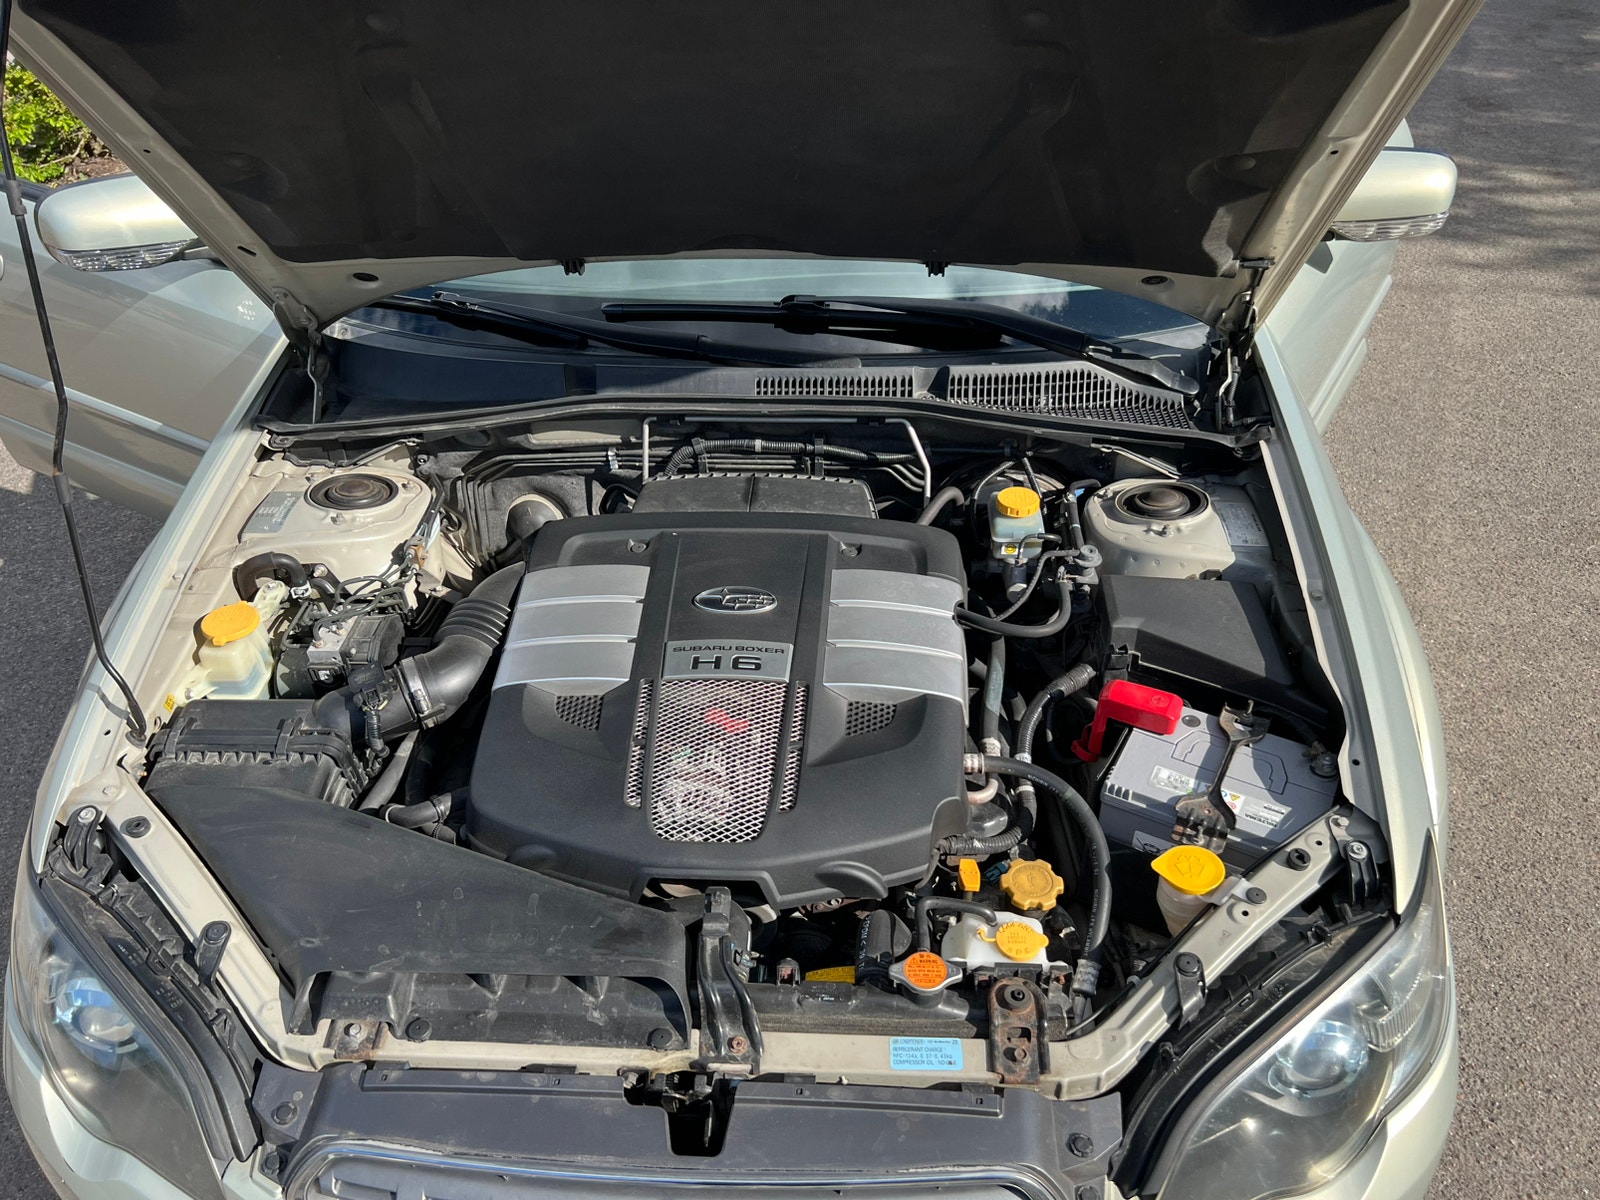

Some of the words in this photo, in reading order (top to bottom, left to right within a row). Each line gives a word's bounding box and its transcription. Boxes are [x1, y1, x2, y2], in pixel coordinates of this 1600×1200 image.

[673, 645, 732, 653] SUBARU
[735, 645, 785, 654] BOXER
[690, 655, 762, 671] H6
